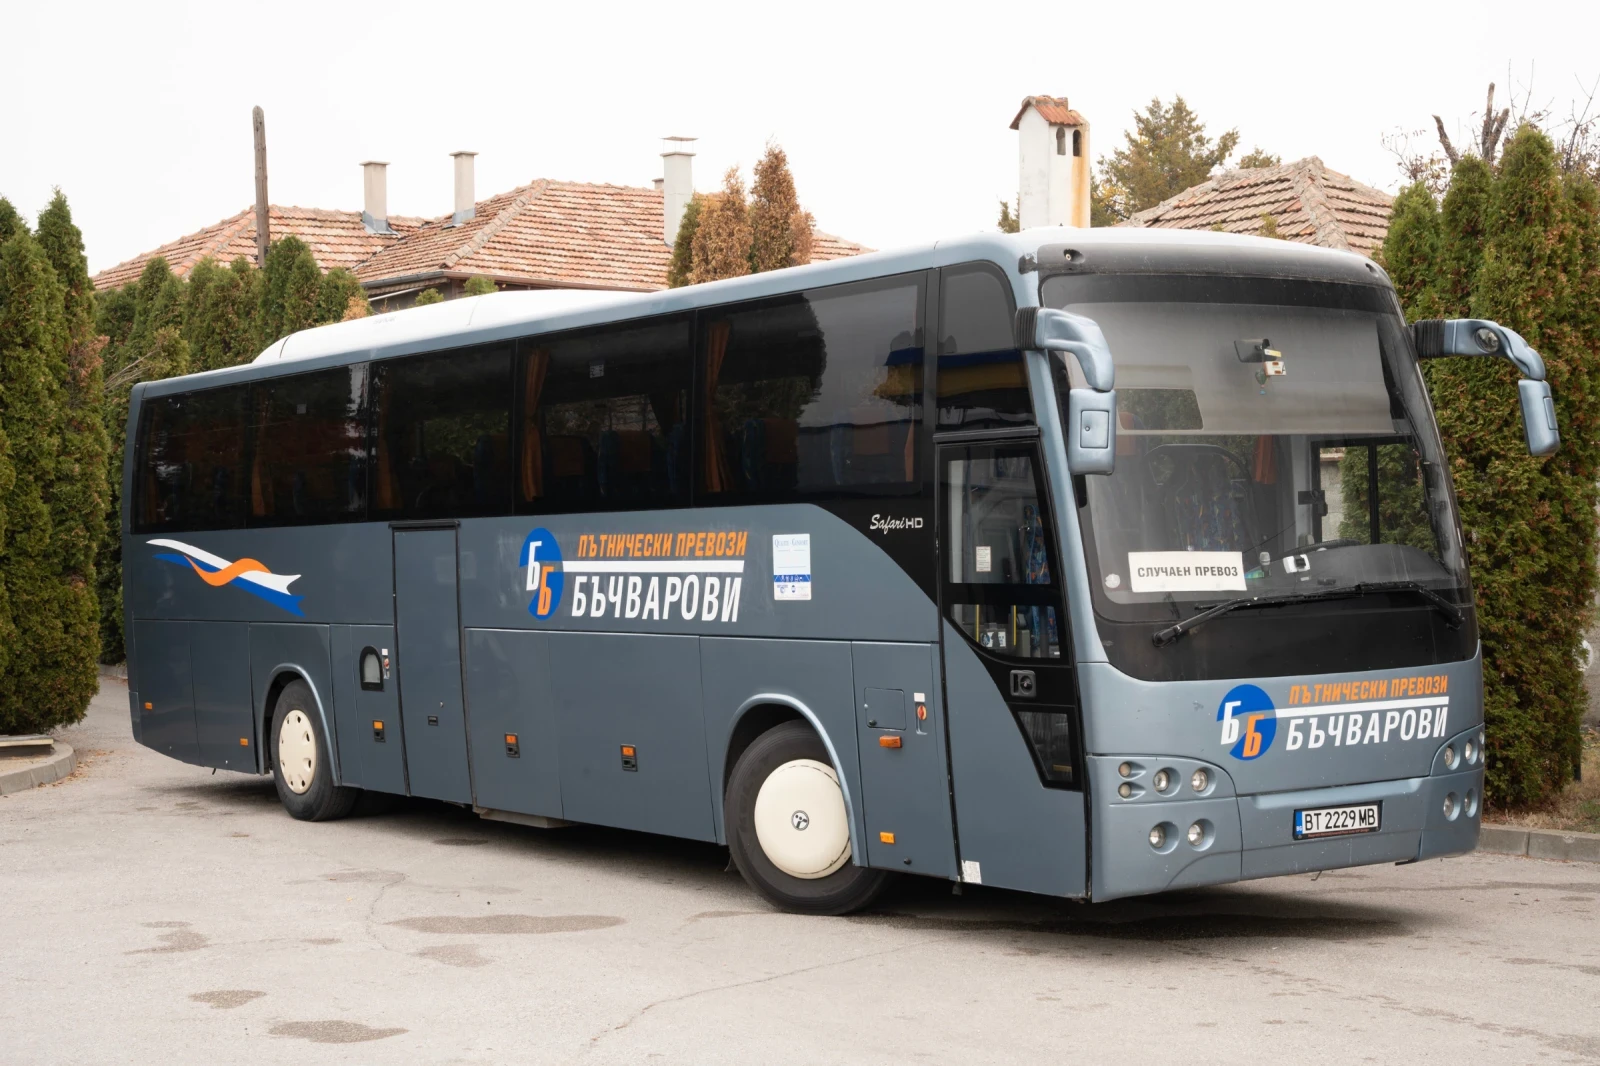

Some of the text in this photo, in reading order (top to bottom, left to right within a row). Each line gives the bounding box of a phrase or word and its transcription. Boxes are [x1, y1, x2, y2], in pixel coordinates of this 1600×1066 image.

[870, 514, 923, 535] Safari HD
[577, 531, 748, 558] ПЪТНИЧЕСКИ ПРЕВОЗИ
[1137, 565, 1238, 578] СЛУЧАЕН ПРЕВОЗ
[571, 574, 743, 623] БЪЧВАРОВИ
[1288, 675, 1449, 705] ПЪТНИЧЕСКИ ПРЕВОЗИ
[1286, 706, 1449, 751] БЪЧВАРОВИ
[1305, 808, 1376, 831] BT 2229 MB
